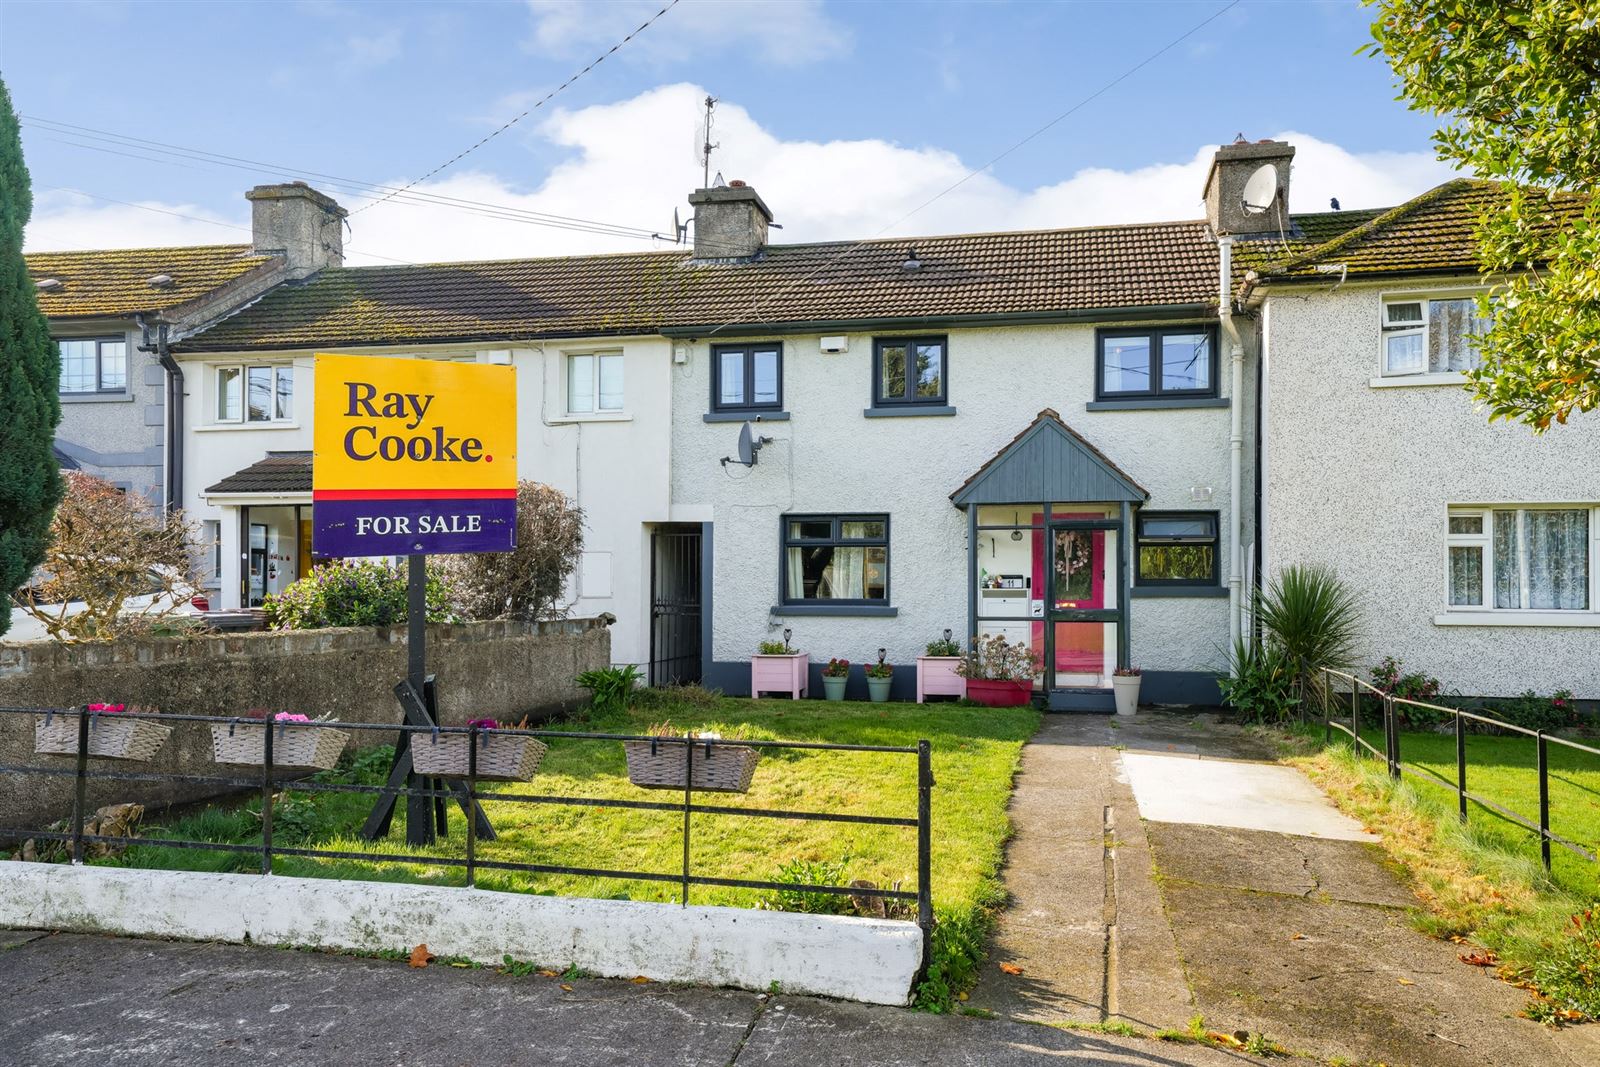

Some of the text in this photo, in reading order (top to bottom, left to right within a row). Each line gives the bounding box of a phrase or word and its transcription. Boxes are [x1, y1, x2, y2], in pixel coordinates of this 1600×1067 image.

[344, 382, 434, 429] Ray
[344, 426, 493, 463] Cooke.
[356, 515, 481, 535] FOR SALE
